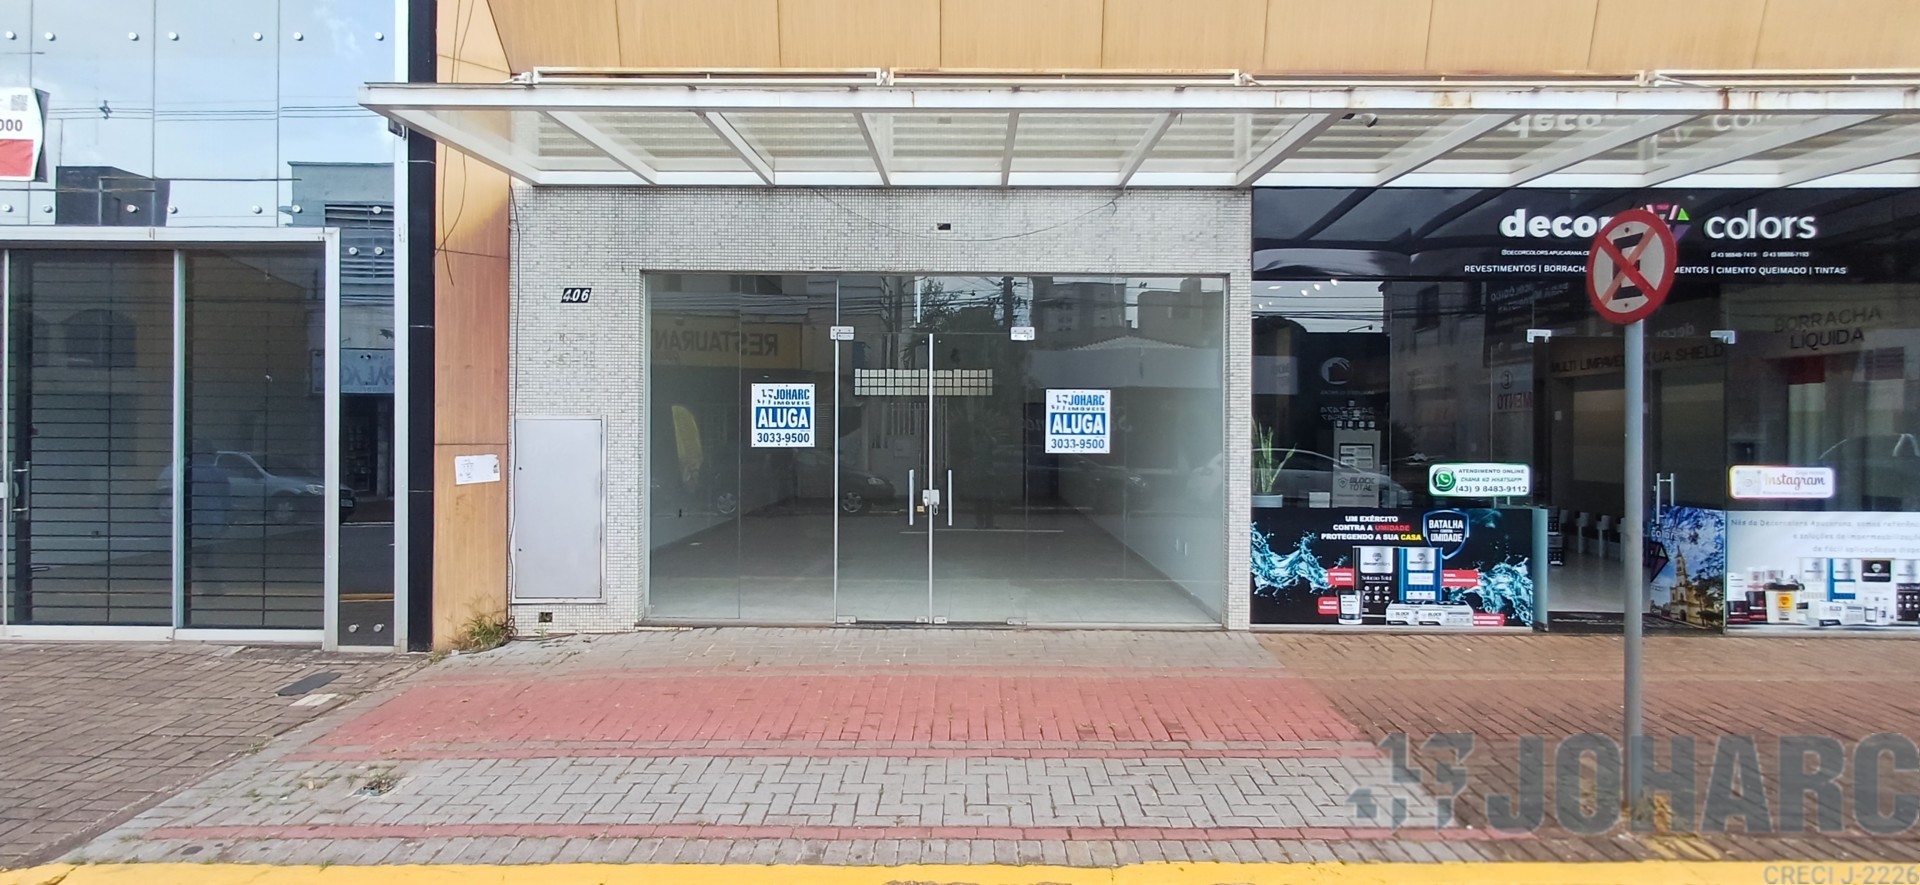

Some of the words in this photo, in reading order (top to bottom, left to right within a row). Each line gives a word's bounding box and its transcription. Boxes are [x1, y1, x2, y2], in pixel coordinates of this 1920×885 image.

[1704, 208, 1817, 240] colors
[1464, 265, 1536, 273] REVESTIMENTOS
[1544, 265, 1587, 273] BORRACH
[1716, 266, 1757, 274] CIMENTO
[1759, 267, 1806, 275] QUEIMADO
[1814, 267, 1846, 275] TINTAS
[563, 289, 590, 301] 406
[1774, 306, 1882, 333] BORRACHA
[1790, 327, 1865, 351] LÍQUIDA
[774, 388, 810, 400] JOHARC
[1068, 394, 1105, 406] JOHARC
[757, 408, 809, 428] ALUGA
[1051, 413, 1104, 434] ALUGA
[757, 432, 810, 443] 3033-9500
[1051, 438, 1105, 449] 3033-9500
[1764, 472, 1826, 491] Instagram
[1455, 485, 1472, 493] (43)
[1428, 519, 1464, 529] BATALHA
[1430, 533, 1463, 542] UMIDADE
